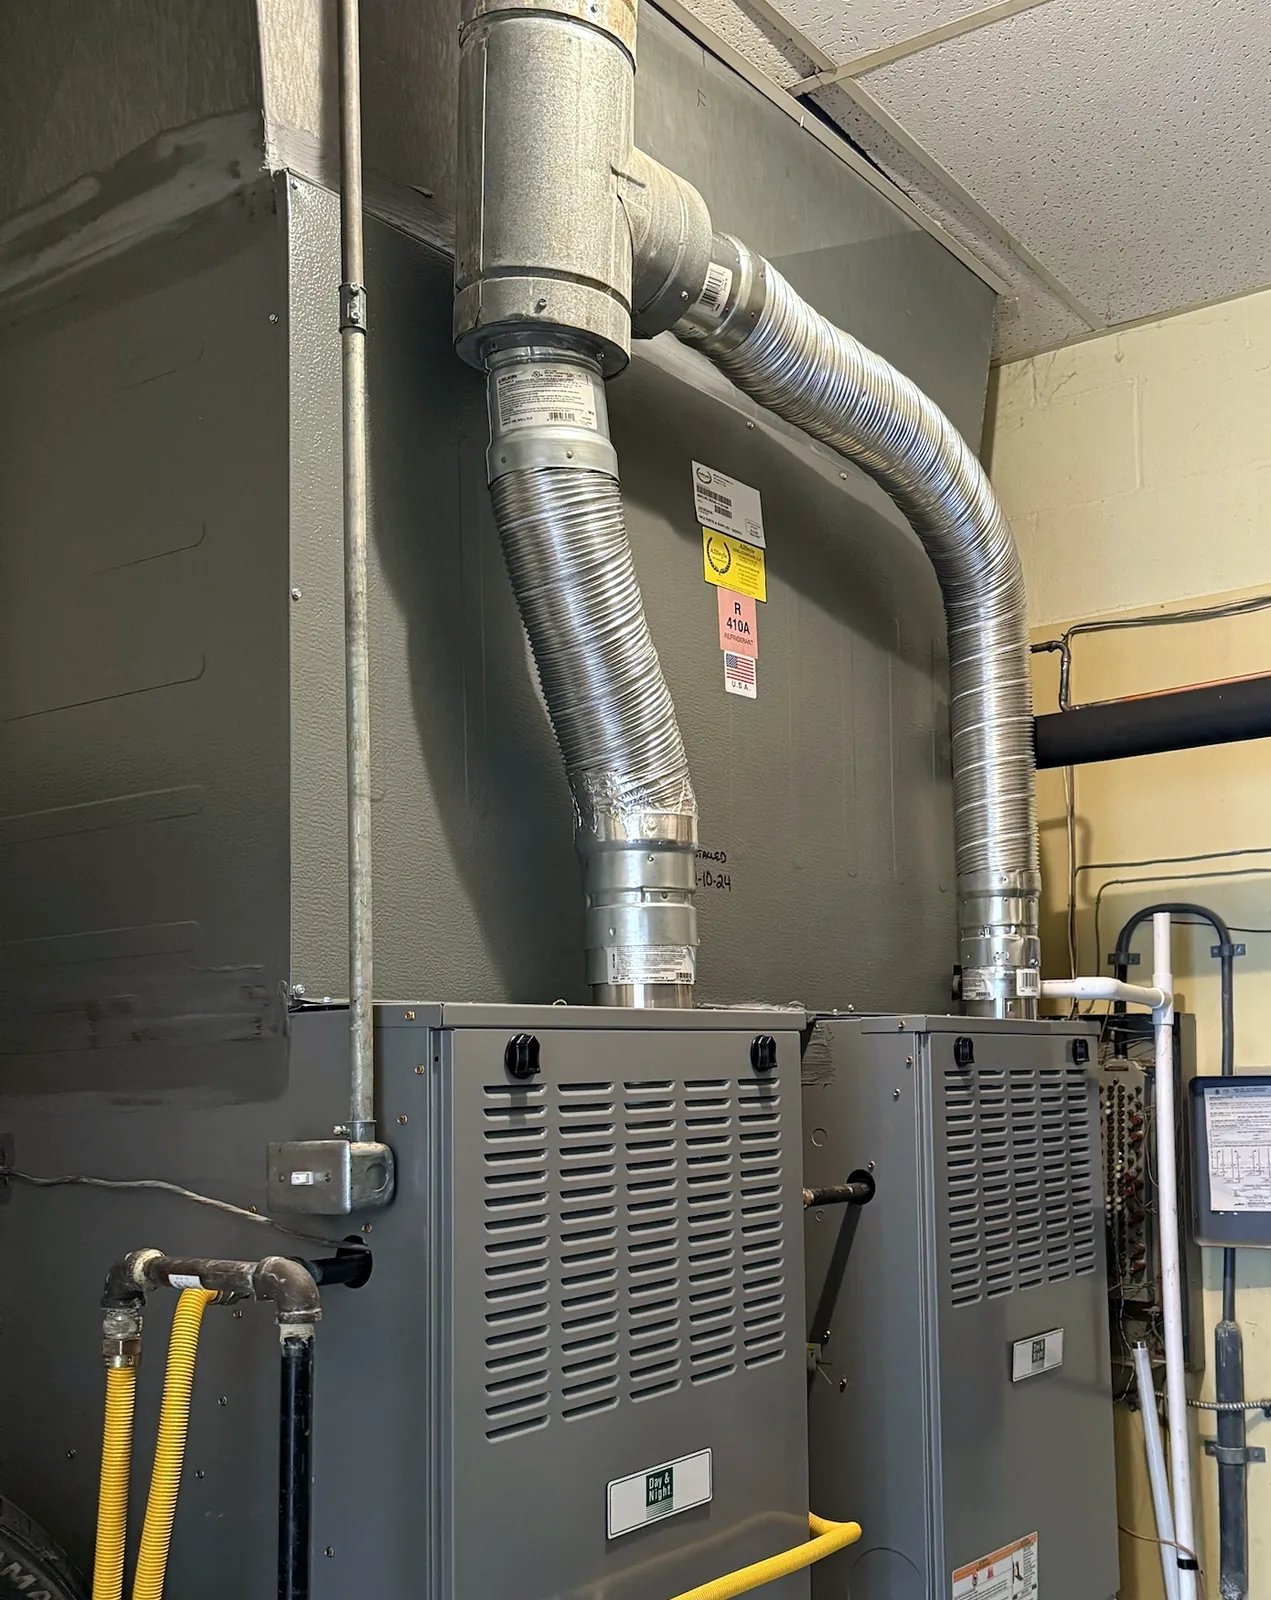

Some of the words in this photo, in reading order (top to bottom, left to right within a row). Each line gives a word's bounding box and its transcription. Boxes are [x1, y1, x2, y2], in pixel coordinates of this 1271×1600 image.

[734, 602, 742, 616] R
[726, 617, 751, 635] 410A
[695, 850, 727, 864] TALLED
[648, 1476, 663, 1490] Day
[664, 1471, 670, 1484] &
